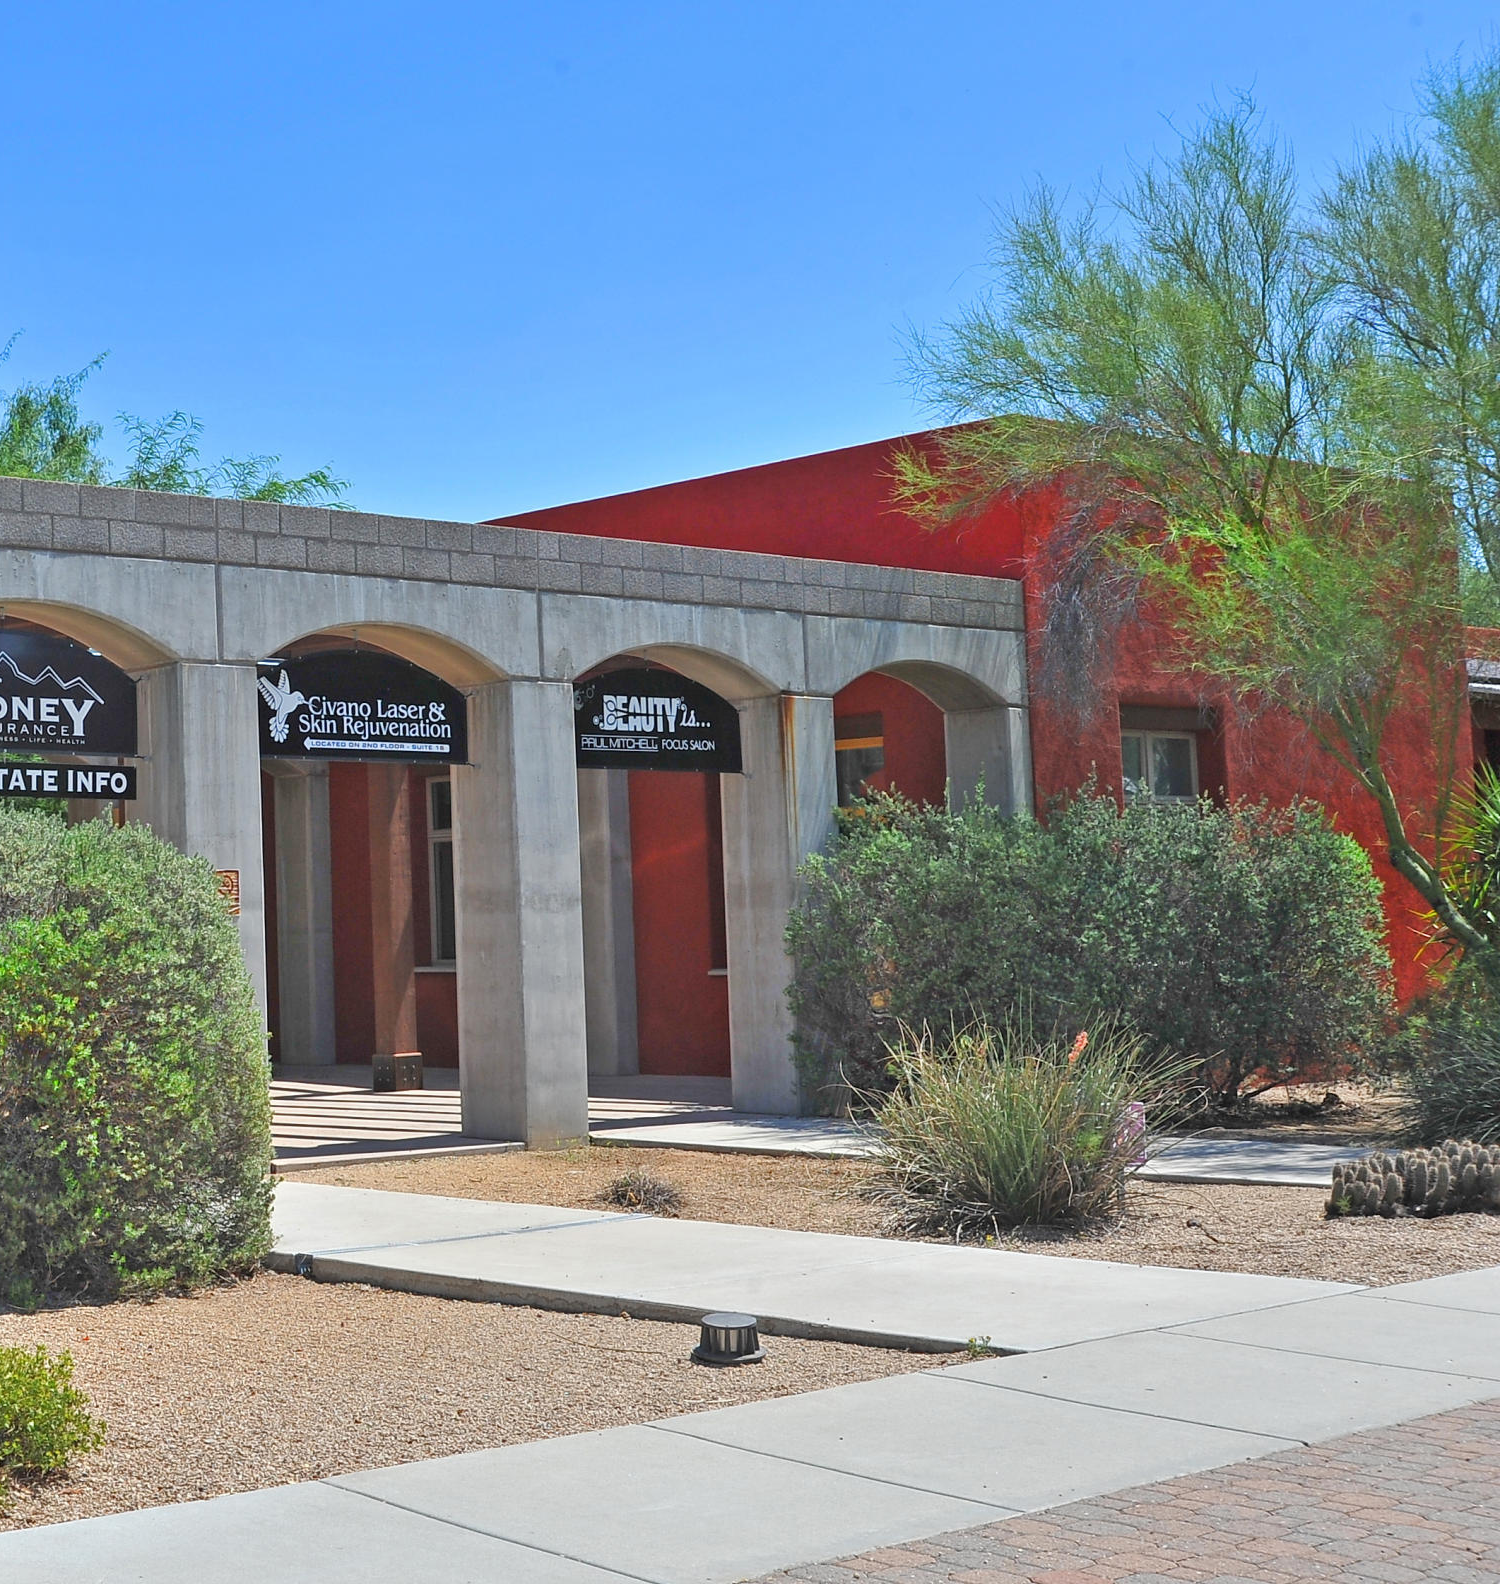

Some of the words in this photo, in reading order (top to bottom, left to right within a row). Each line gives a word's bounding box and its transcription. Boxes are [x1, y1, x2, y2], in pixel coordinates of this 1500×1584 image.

[308, 696, 371, 718] Civano
[378, 700, 425, 720] Laser
[428, 702, 447, 722] &
[600, 694, 679, 732] BEAUTY
[299, 714, 337, 734] Skin
[343, 716, 451, 740] Rejuvenation
[581, 737, 608, 748] PAUL
[609, 738, 658, 750] MITCHELL
[661, 738, 689, 750] FOCUS
[690, 739, 715, 751] SALON
[67, 770, 128, 794] INFO
